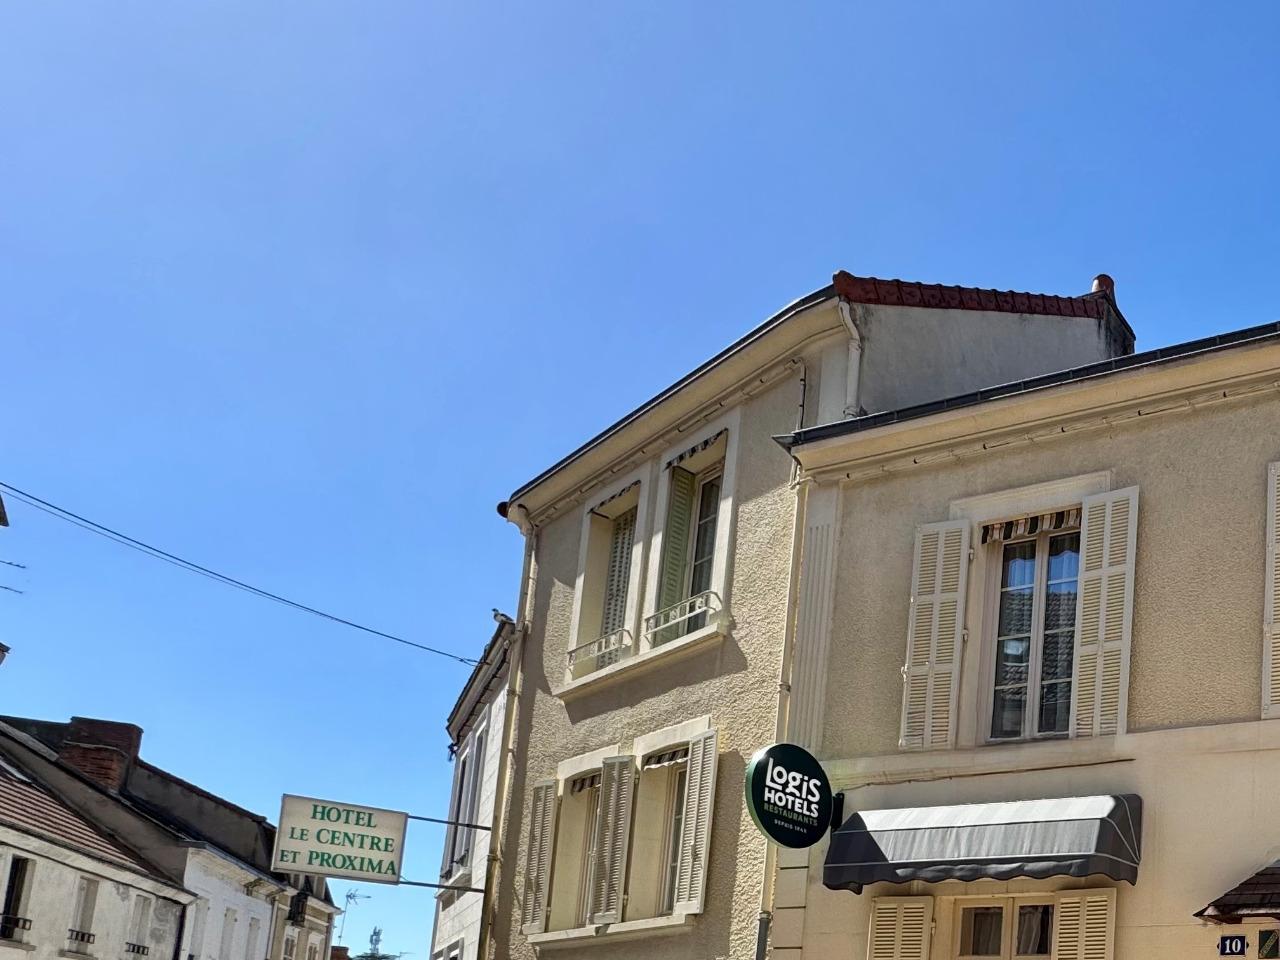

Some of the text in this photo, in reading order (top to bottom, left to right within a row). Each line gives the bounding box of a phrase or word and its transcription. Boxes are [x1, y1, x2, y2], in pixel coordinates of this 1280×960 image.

[763, 802, 818, 827] RESTAURANTS
[764, 786, 819, 818] HOTELS
[311, 804, 377, 829] HOTEL
[288, 826, 395, 854] LE CENTRE
[279, 849, 397, 876] ET PROXIMA
[1224, 938, 1241, 953] 10
